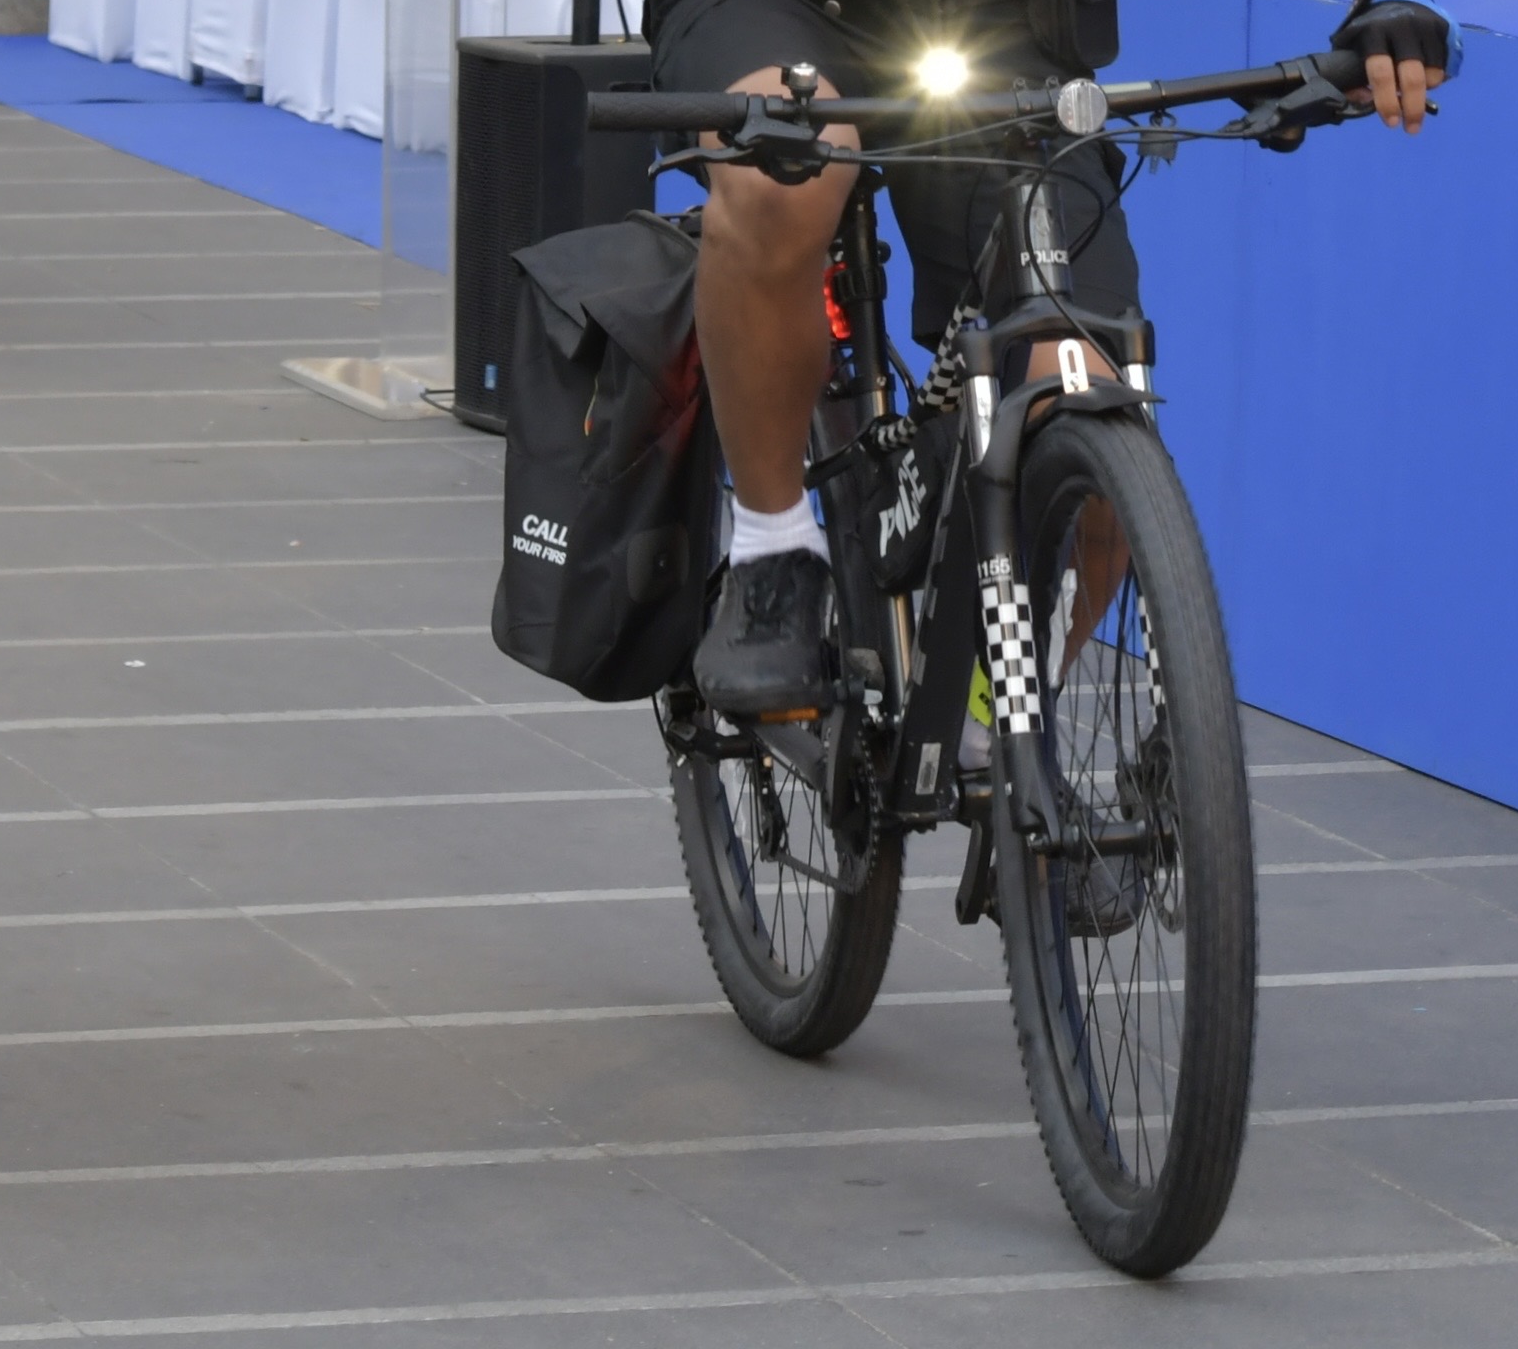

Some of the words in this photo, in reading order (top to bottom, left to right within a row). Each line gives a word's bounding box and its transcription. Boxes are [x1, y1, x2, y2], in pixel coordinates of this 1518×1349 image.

[1020, 249, 1069, 267] POLICE
[522, 513, 568, 548] CALL
[512, 534, 543, 558] YOUR
[541, 546, 567, 566] FIRS
